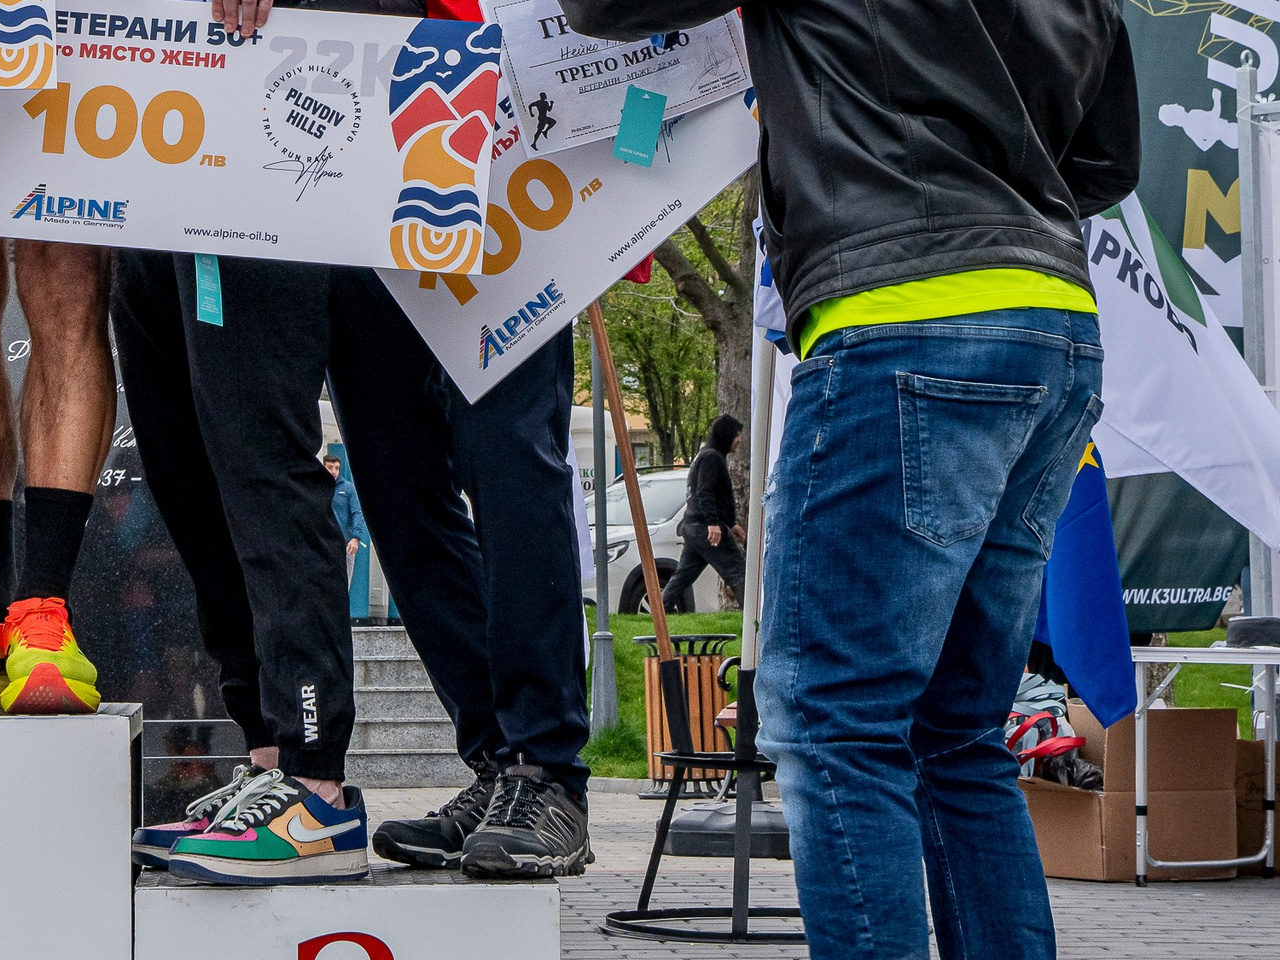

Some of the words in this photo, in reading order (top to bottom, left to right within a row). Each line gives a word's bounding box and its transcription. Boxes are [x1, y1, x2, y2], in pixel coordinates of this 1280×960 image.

[56, 11, 198, 44] ЕТЕРАНИ
[78, 43, 156, 65] МЯСТО
[160, 48, 226, 70] ЖЕНИ
[555, 56, 619, 84] ТРЕТО
[578, 77, 622, 95] ВЕТЕРАНИ
[626, 66, 652, 81] МЪЖЕ
[657, 62, 667, 72] 22
[265, 66, 303, 100] PLOVDIV
[308, 64, 339, 79] HILLS
[341, 77, 352, 89] IN
[347, 91, 362, 143] MARKOVO
[284, 87, 345, 128] PLOVDIV
[22, 82, 206, 166] 100
[199, 152, 226, 168] лв
[262, 117, 279, 148] TRAIL
[281, 147, 301, 161] RUN
[285, 109, 327, 140] HILLS
[10, 183, 128, 223] ALPINE
[578, 177, 604, 203] лв
[83, 220, 125, 230] Germany
[183, 225, 279, 245] www.alpine-oil.bg
[607, 198, 683, 264] www.alpine-oil.bg
[479, 280, 564, 371] ALPINE
[505, 333, 526, 351] Made
[534, 298, 566, 327] Germany
[1122, 586, 1233, 605] WW.K3ULTRA.BG
[303, 684, 317, 743] WEAR
